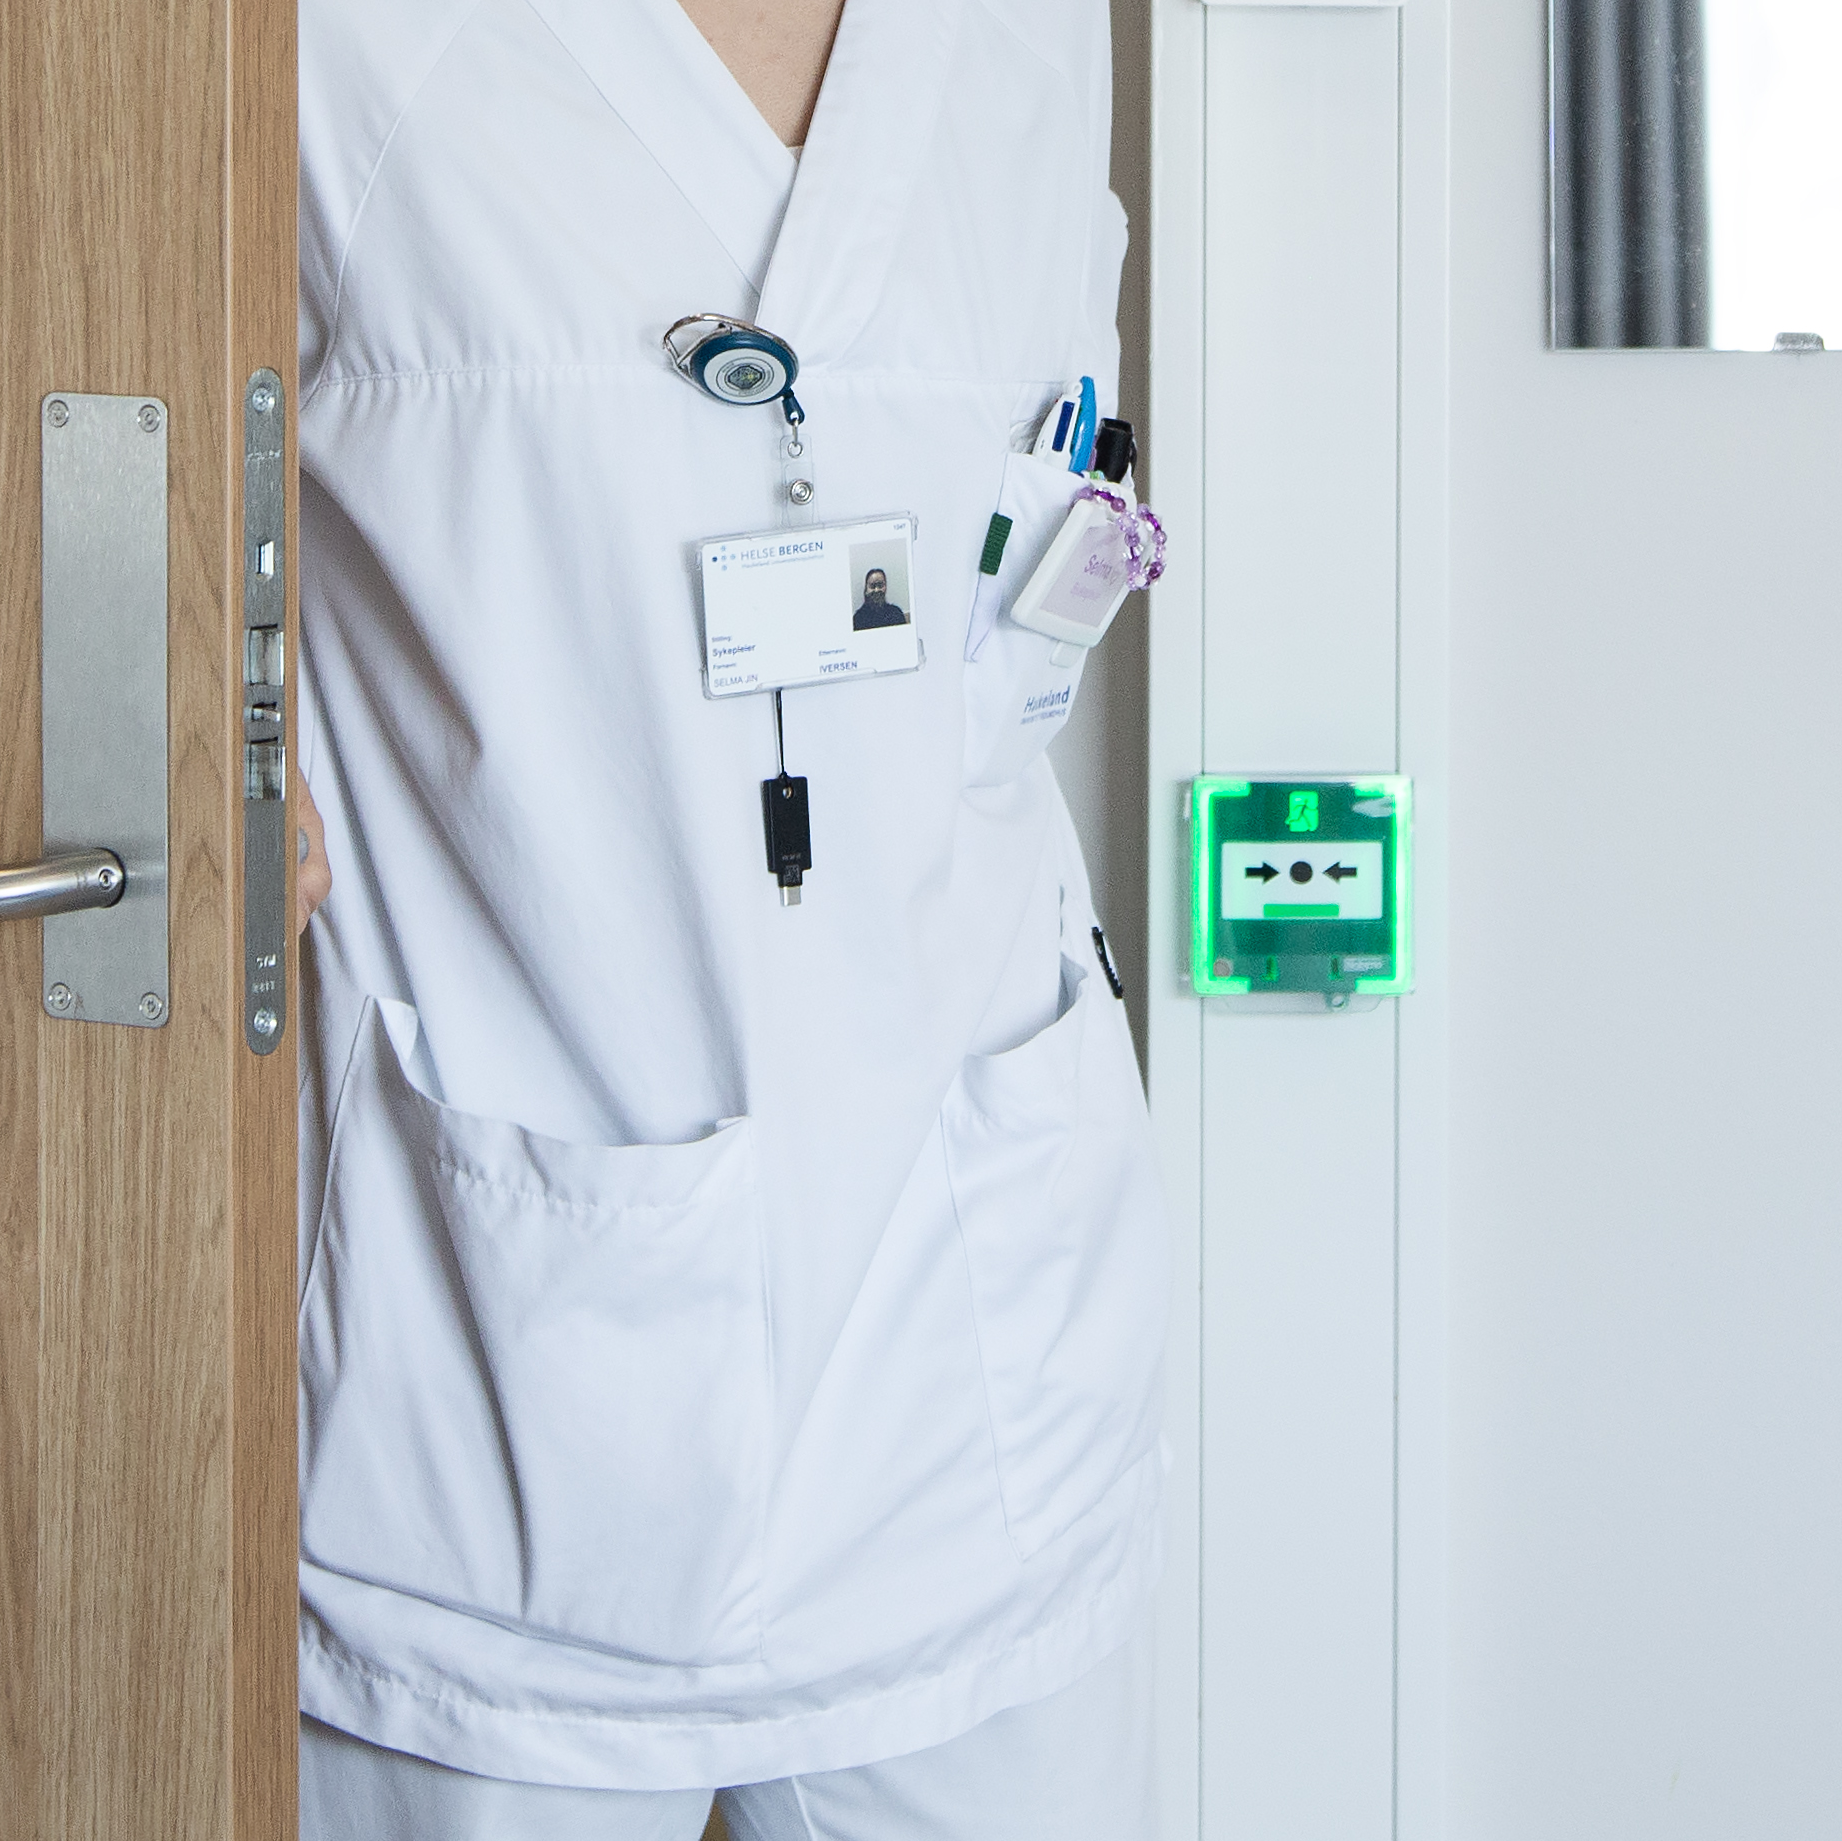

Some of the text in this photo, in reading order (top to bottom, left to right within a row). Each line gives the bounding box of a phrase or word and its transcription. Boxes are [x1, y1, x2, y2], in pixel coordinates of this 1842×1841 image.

[740, 546, 776, 561] HELSE
[778, 540, 824, 556] BERGEN
[712, 644, 756, 658] Sykepleier
[819, 661, 858, 674] IVERSEN
[713, 674, 759, 688] SELMA JIN
